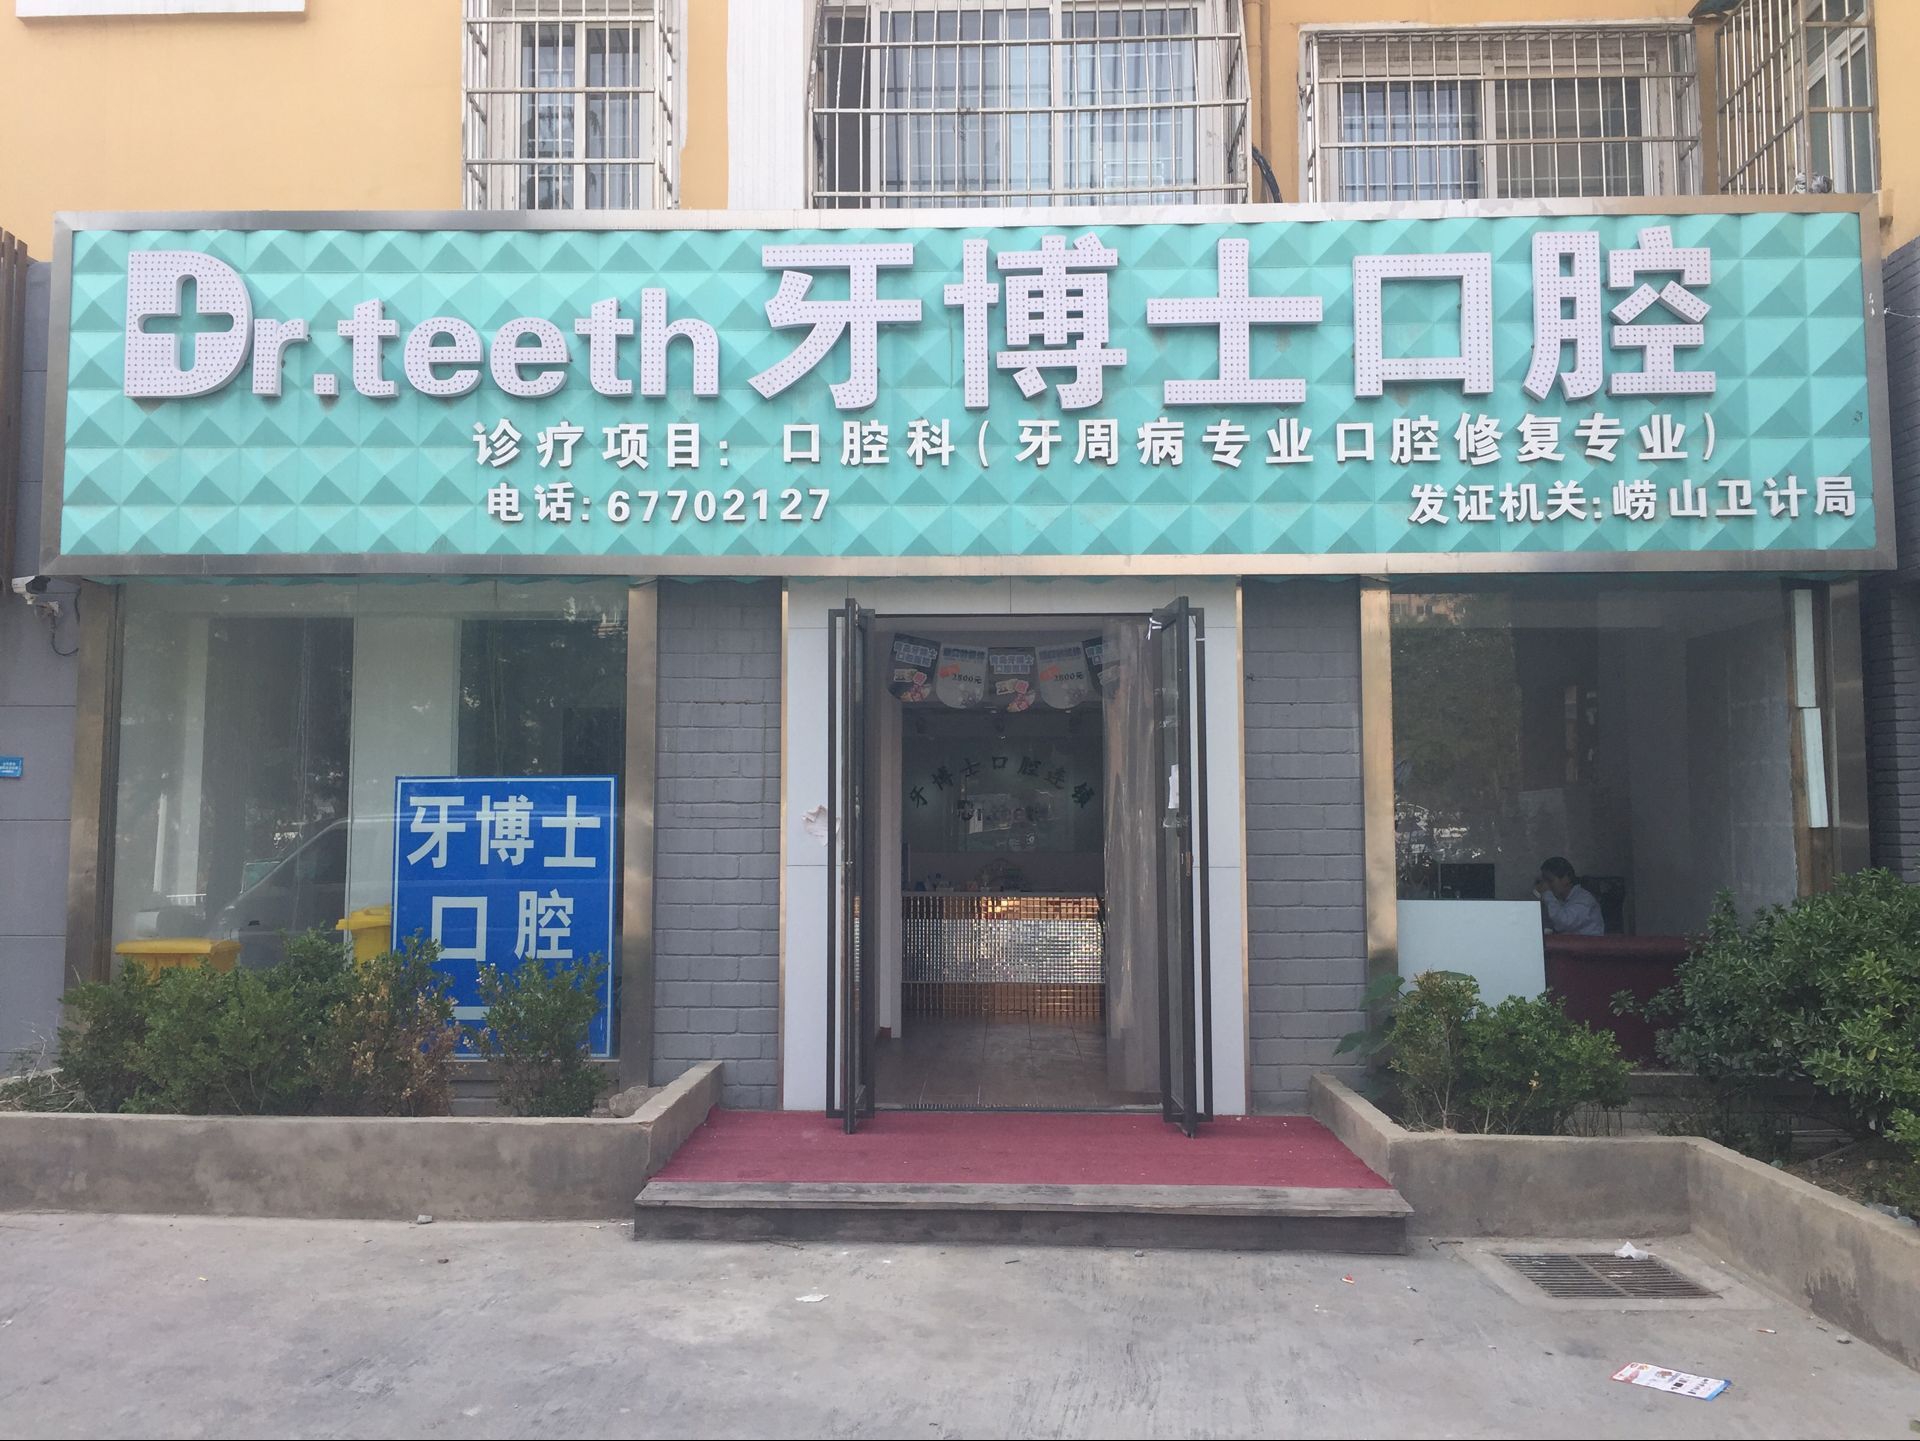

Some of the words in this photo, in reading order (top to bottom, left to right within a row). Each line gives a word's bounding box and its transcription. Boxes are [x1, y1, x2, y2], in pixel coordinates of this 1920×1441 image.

[124, 249, 720, 400] Dr.teeth
[747, 225, 1717, 412] 牙博士口腔
[486, 482, 831, 523] 电话:67702127
[1408, 475, 1857, 526] 发证机关:崂山卫计局
[406, 794, 601, 869] 牙博士
[431, 888, 574, 962] 口腔
